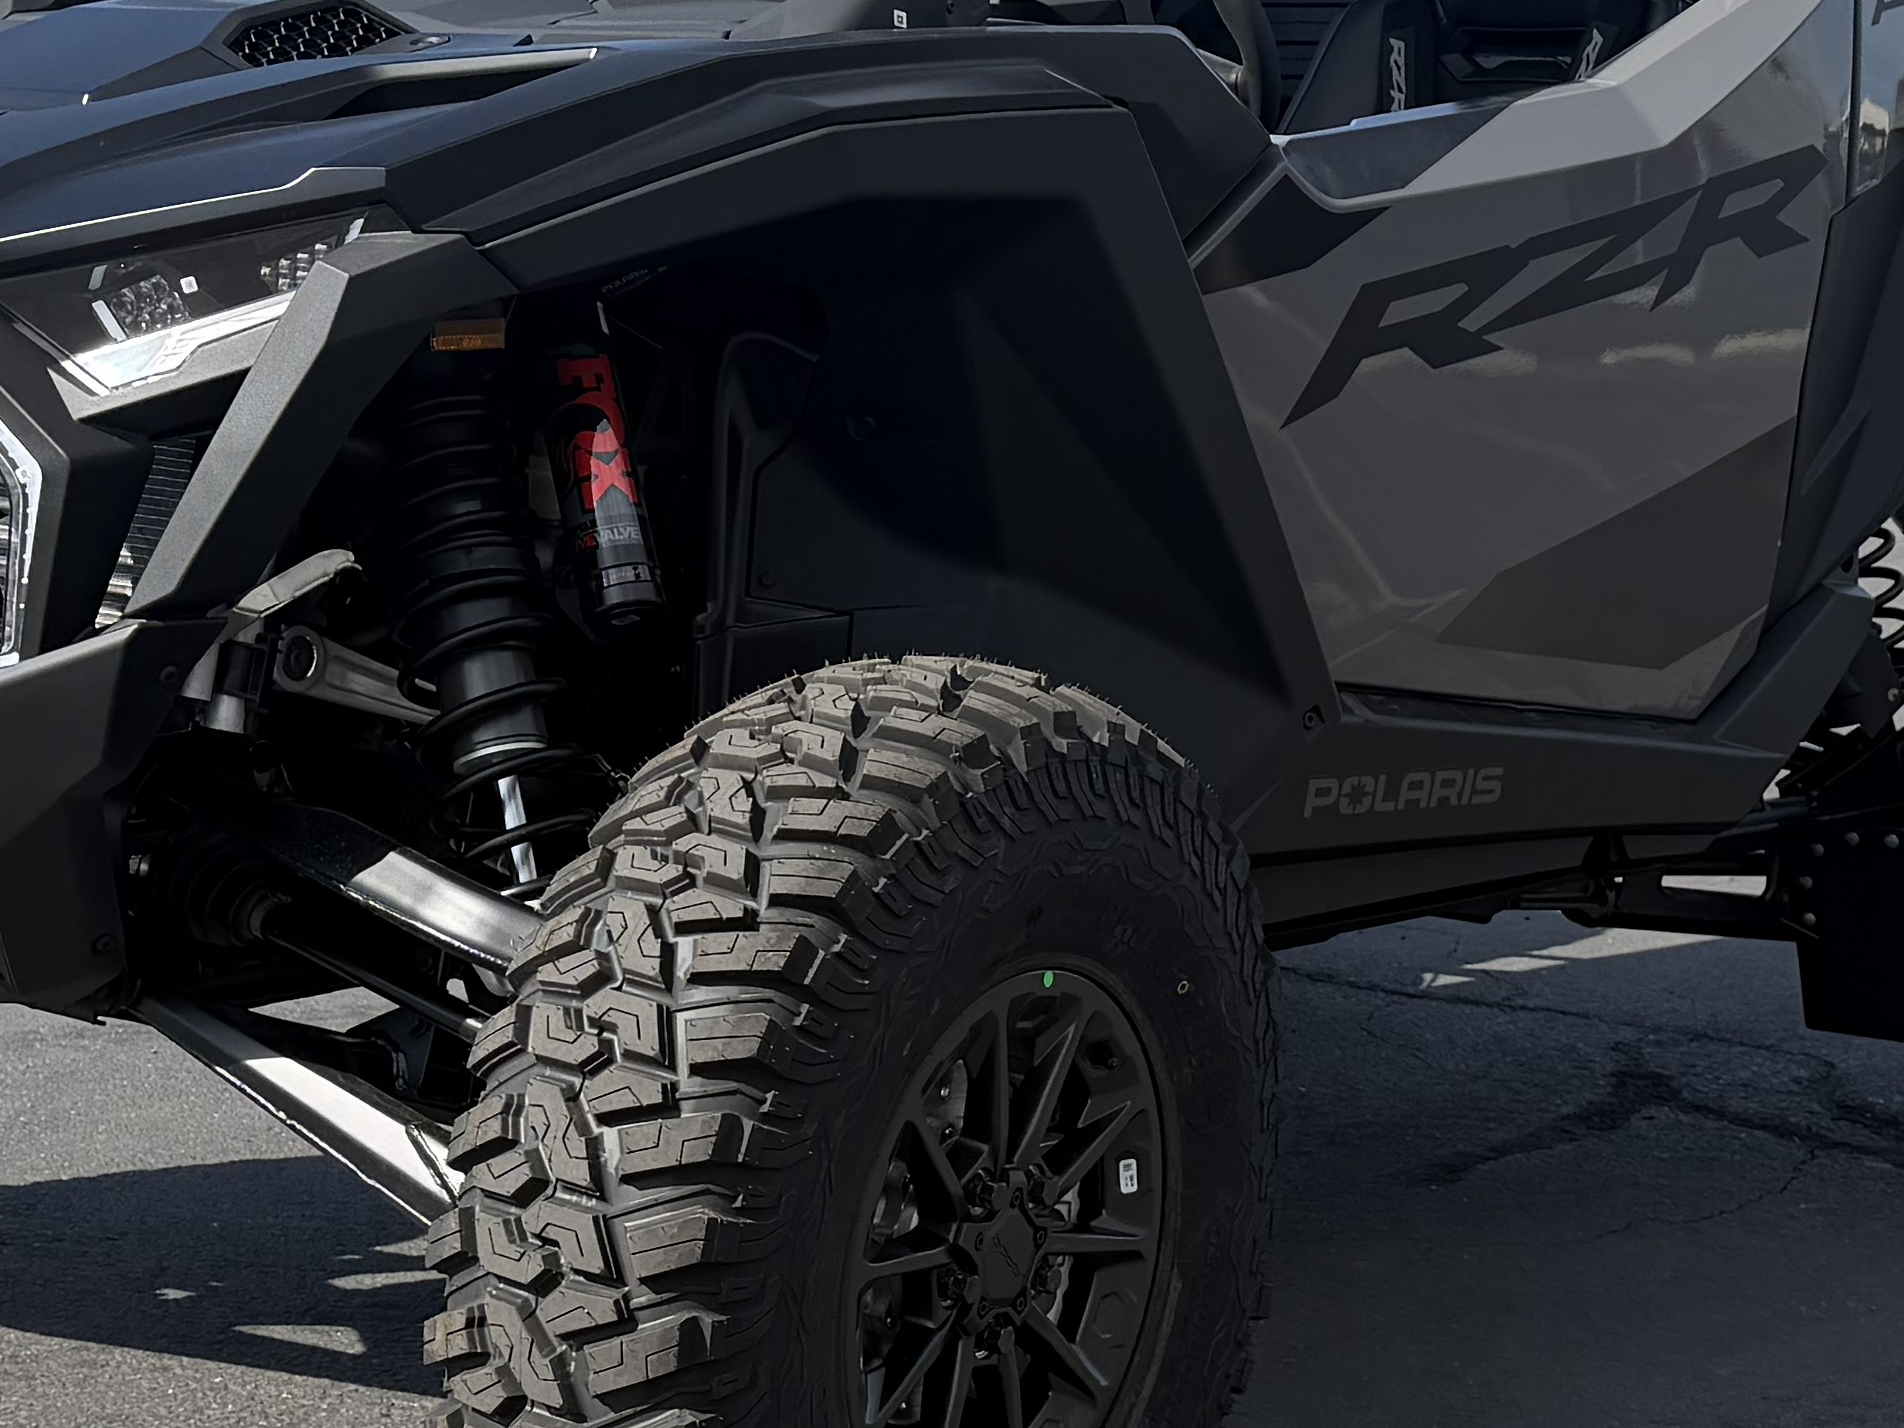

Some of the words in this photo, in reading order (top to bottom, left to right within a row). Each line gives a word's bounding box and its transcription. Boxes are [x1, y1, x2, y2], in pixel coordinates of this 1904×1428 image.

[1280, 144, 1830, 430] RZR
[556, 354, 639, 510] FOX
[1303, 766, 1504, 818] POLARIS
